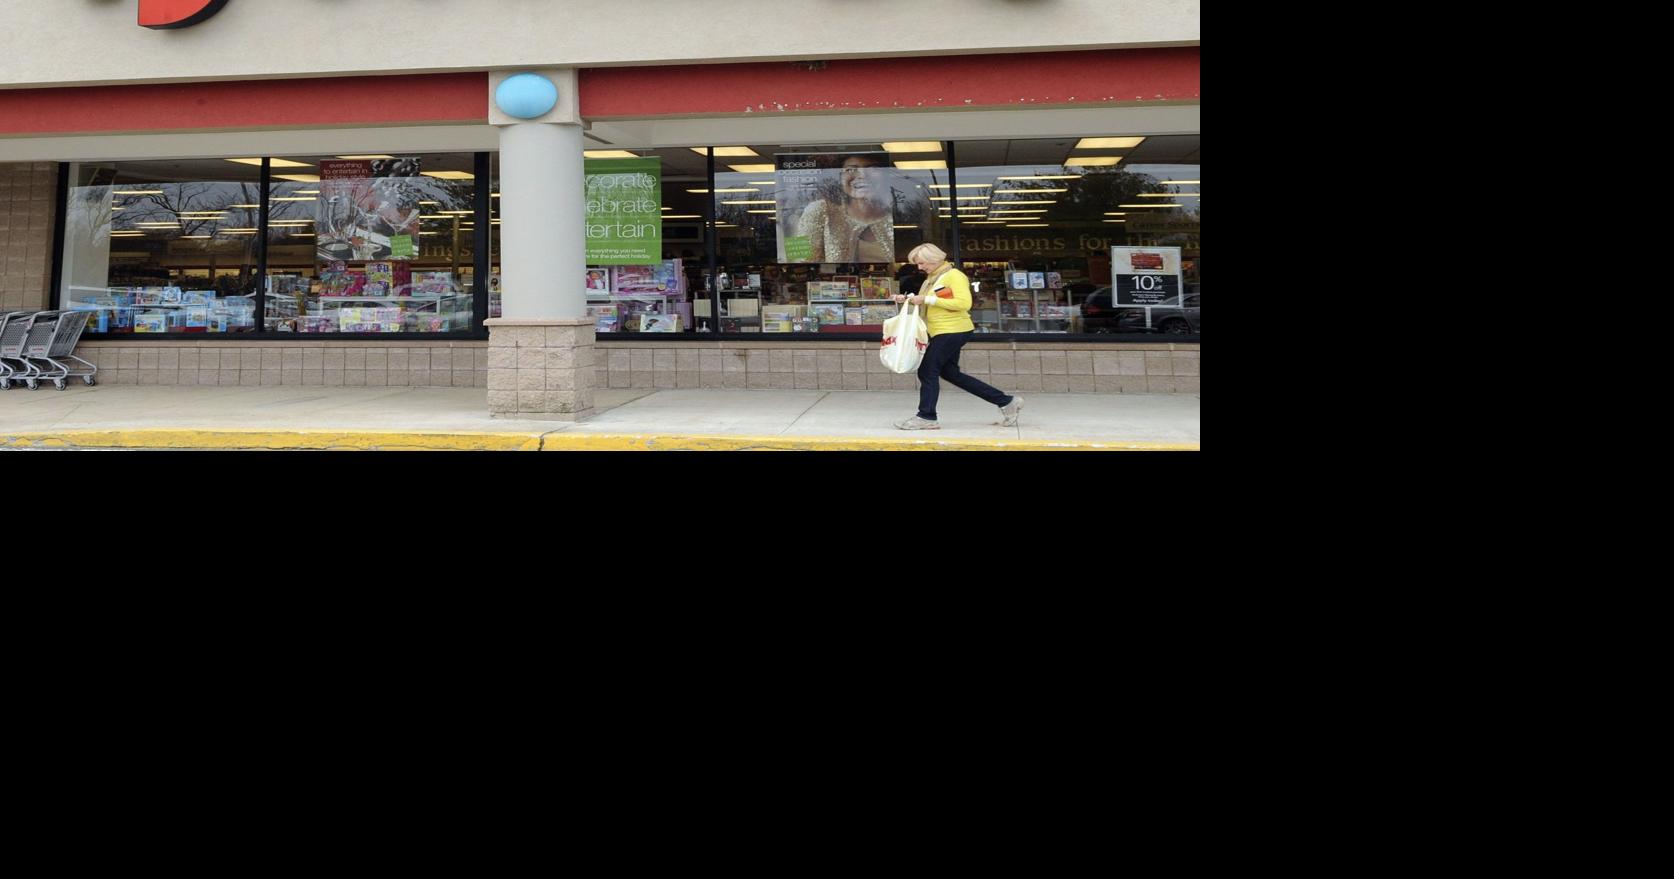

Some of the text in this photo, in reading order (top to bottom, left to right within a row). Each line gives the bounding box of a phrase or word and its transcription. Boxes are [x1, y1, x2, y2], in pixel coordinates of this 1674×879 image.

[782, 160, 817, 168] special
[584, 172, 657, 188] corate
[586, 196, 657, 213] ebrate
[585, 220, 656, 238] tertain
[958, 233, 1065, 251] fashions
[1078, 233, 1113, 251] for
